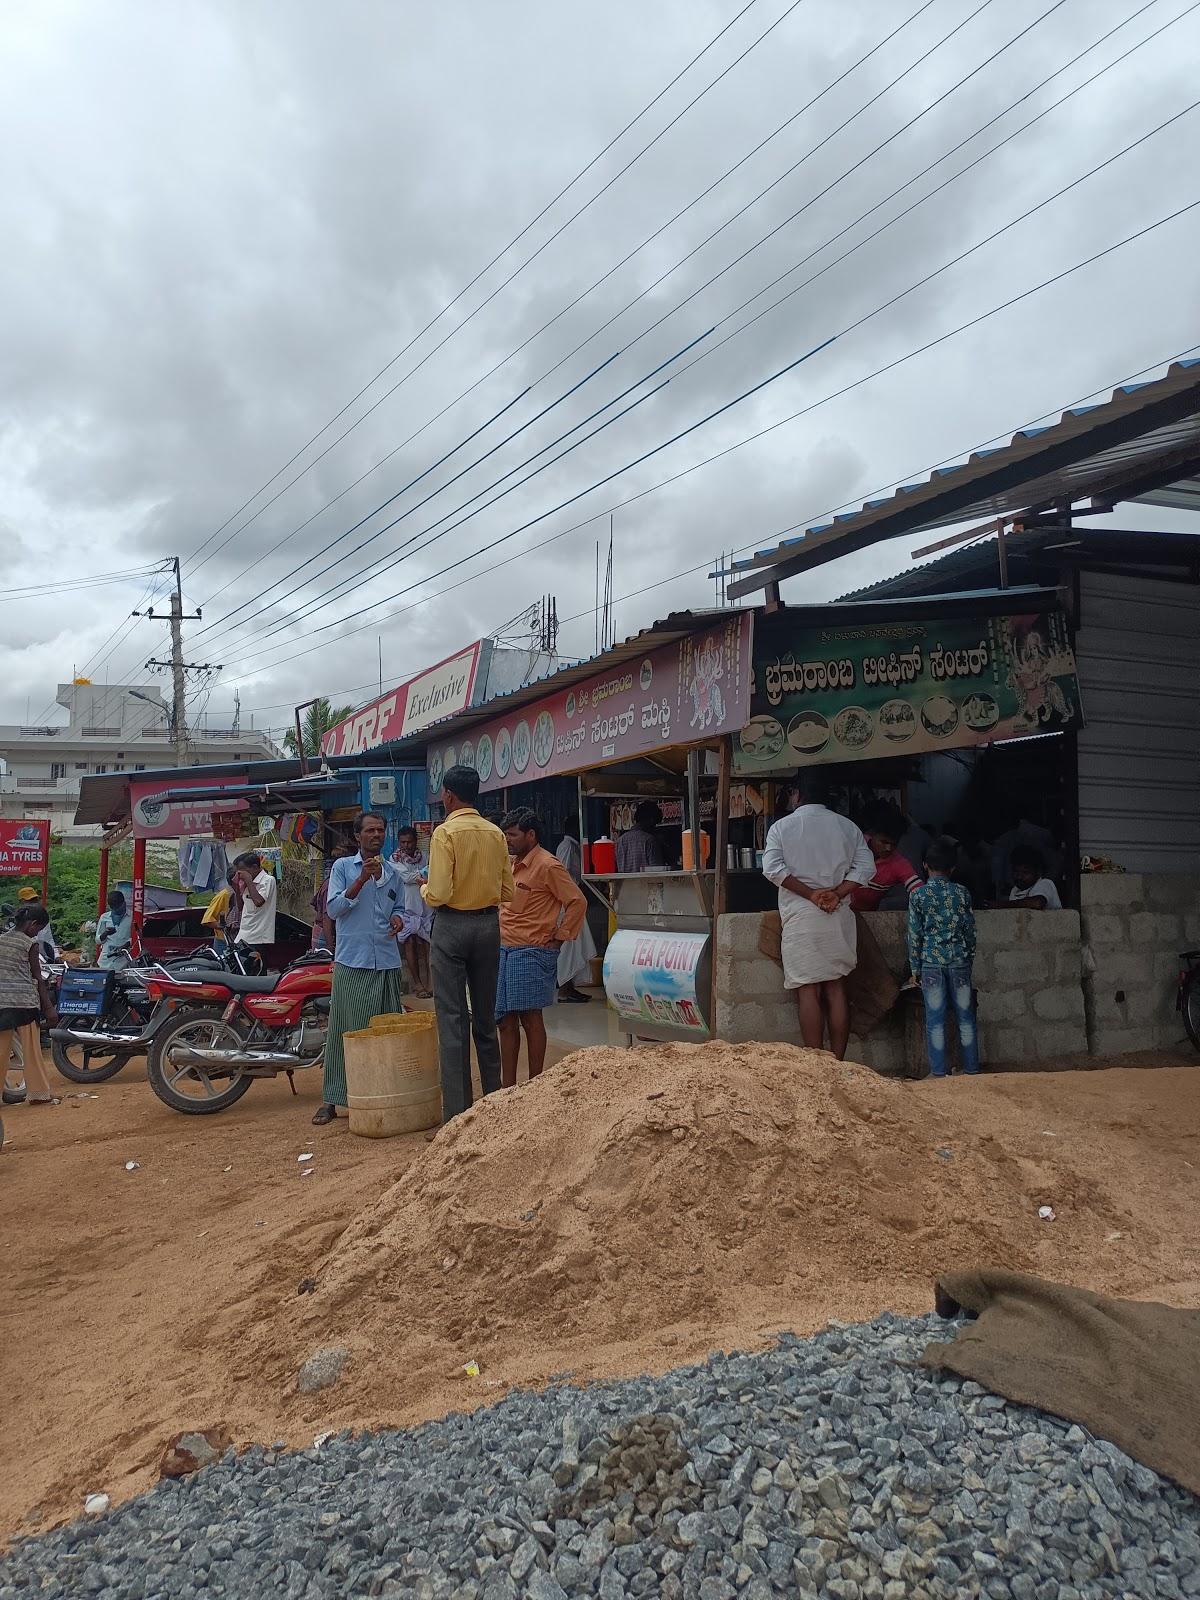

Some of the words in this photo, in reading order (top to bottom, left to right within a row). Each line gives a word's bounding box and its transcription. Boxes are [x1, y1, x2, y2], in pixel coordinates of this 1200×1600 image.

[766, 656, 854, 705] ಭ್ರಮರಾಂಬ
[929, 641, 988, 678] ಸೆಂಟರ್
[340, 694, 397, 755] MRF
[407, 674, 466, 720] Exclusive
[641, 697, 671, 739] ಮಸ್ಕಿ
[12, 851, 43, 862] TYRES
[134, 878, 144, 913] MRF
[632, 938, 656, 967] TEA
[655, 939, 704, 972] POINT
